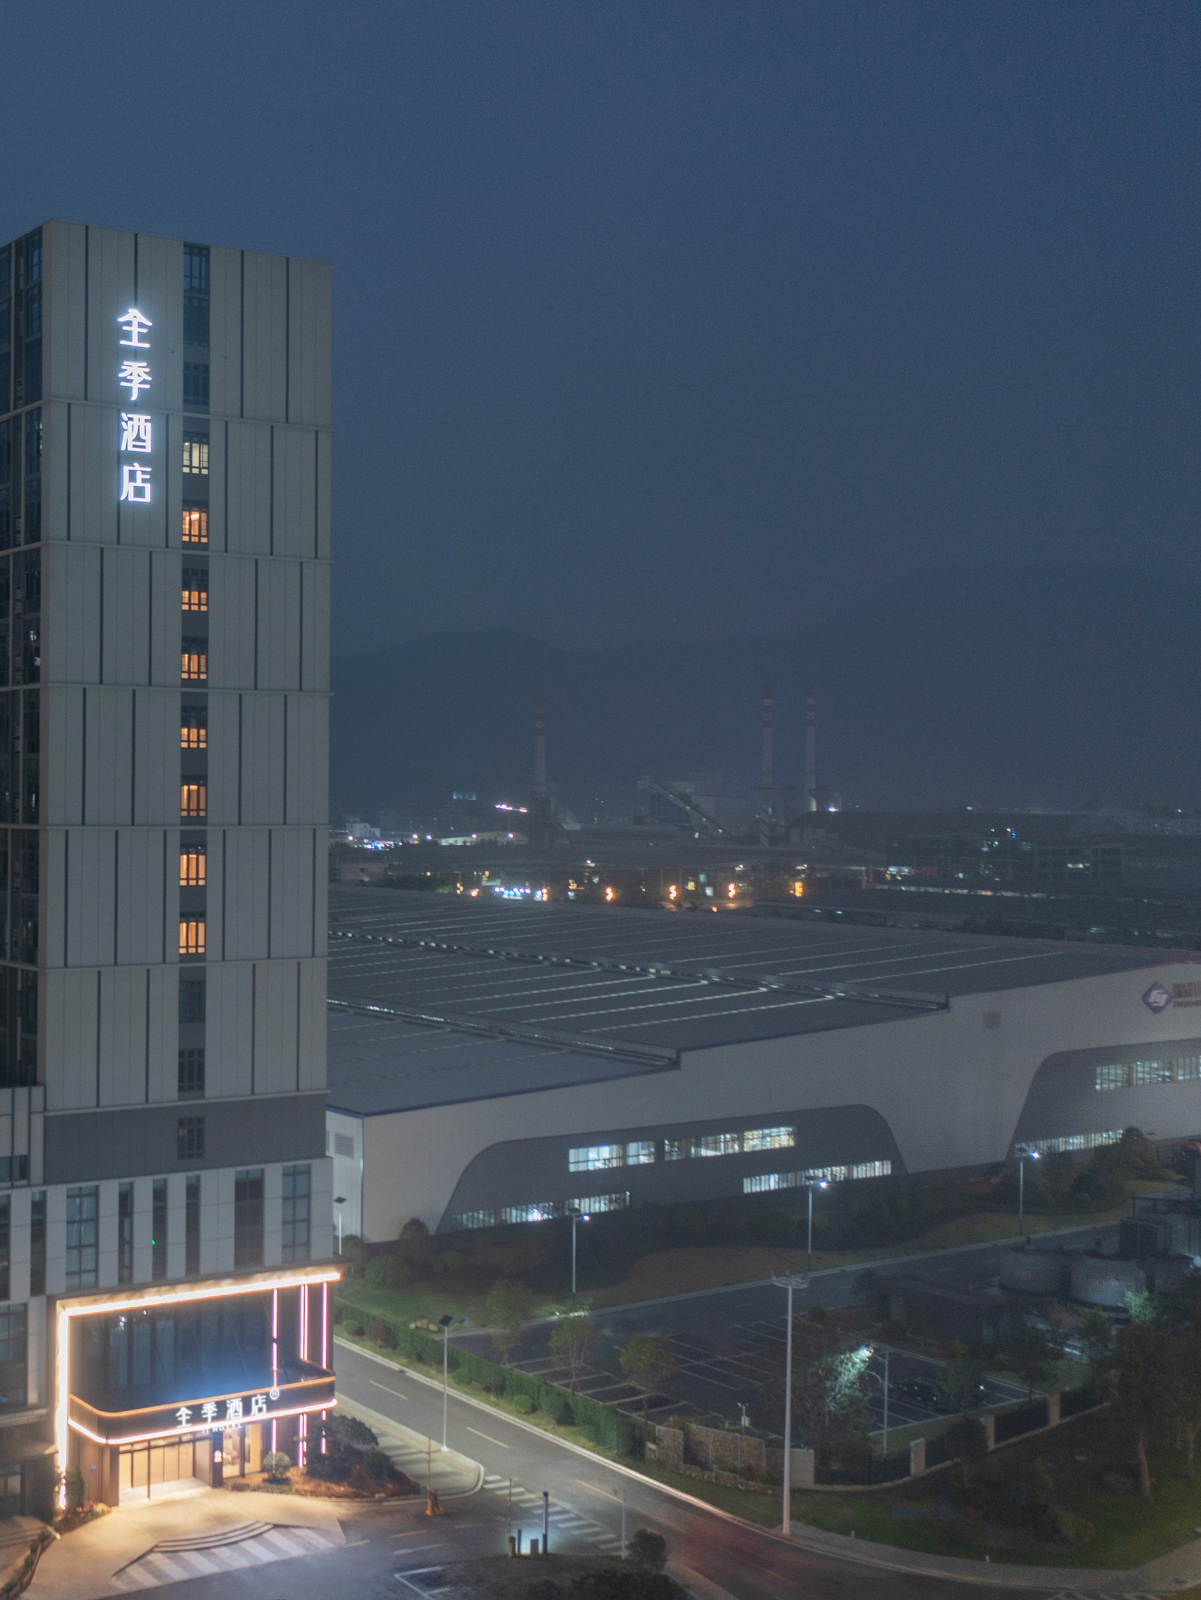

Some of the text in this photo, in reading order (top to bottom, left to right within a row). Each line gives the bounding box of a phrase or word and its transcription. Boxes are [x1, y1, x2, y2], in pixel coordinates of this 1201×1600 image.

[117, 308, 153, 503] 全季酒店
[175, 1394, 267, 1428] 全季酒店
